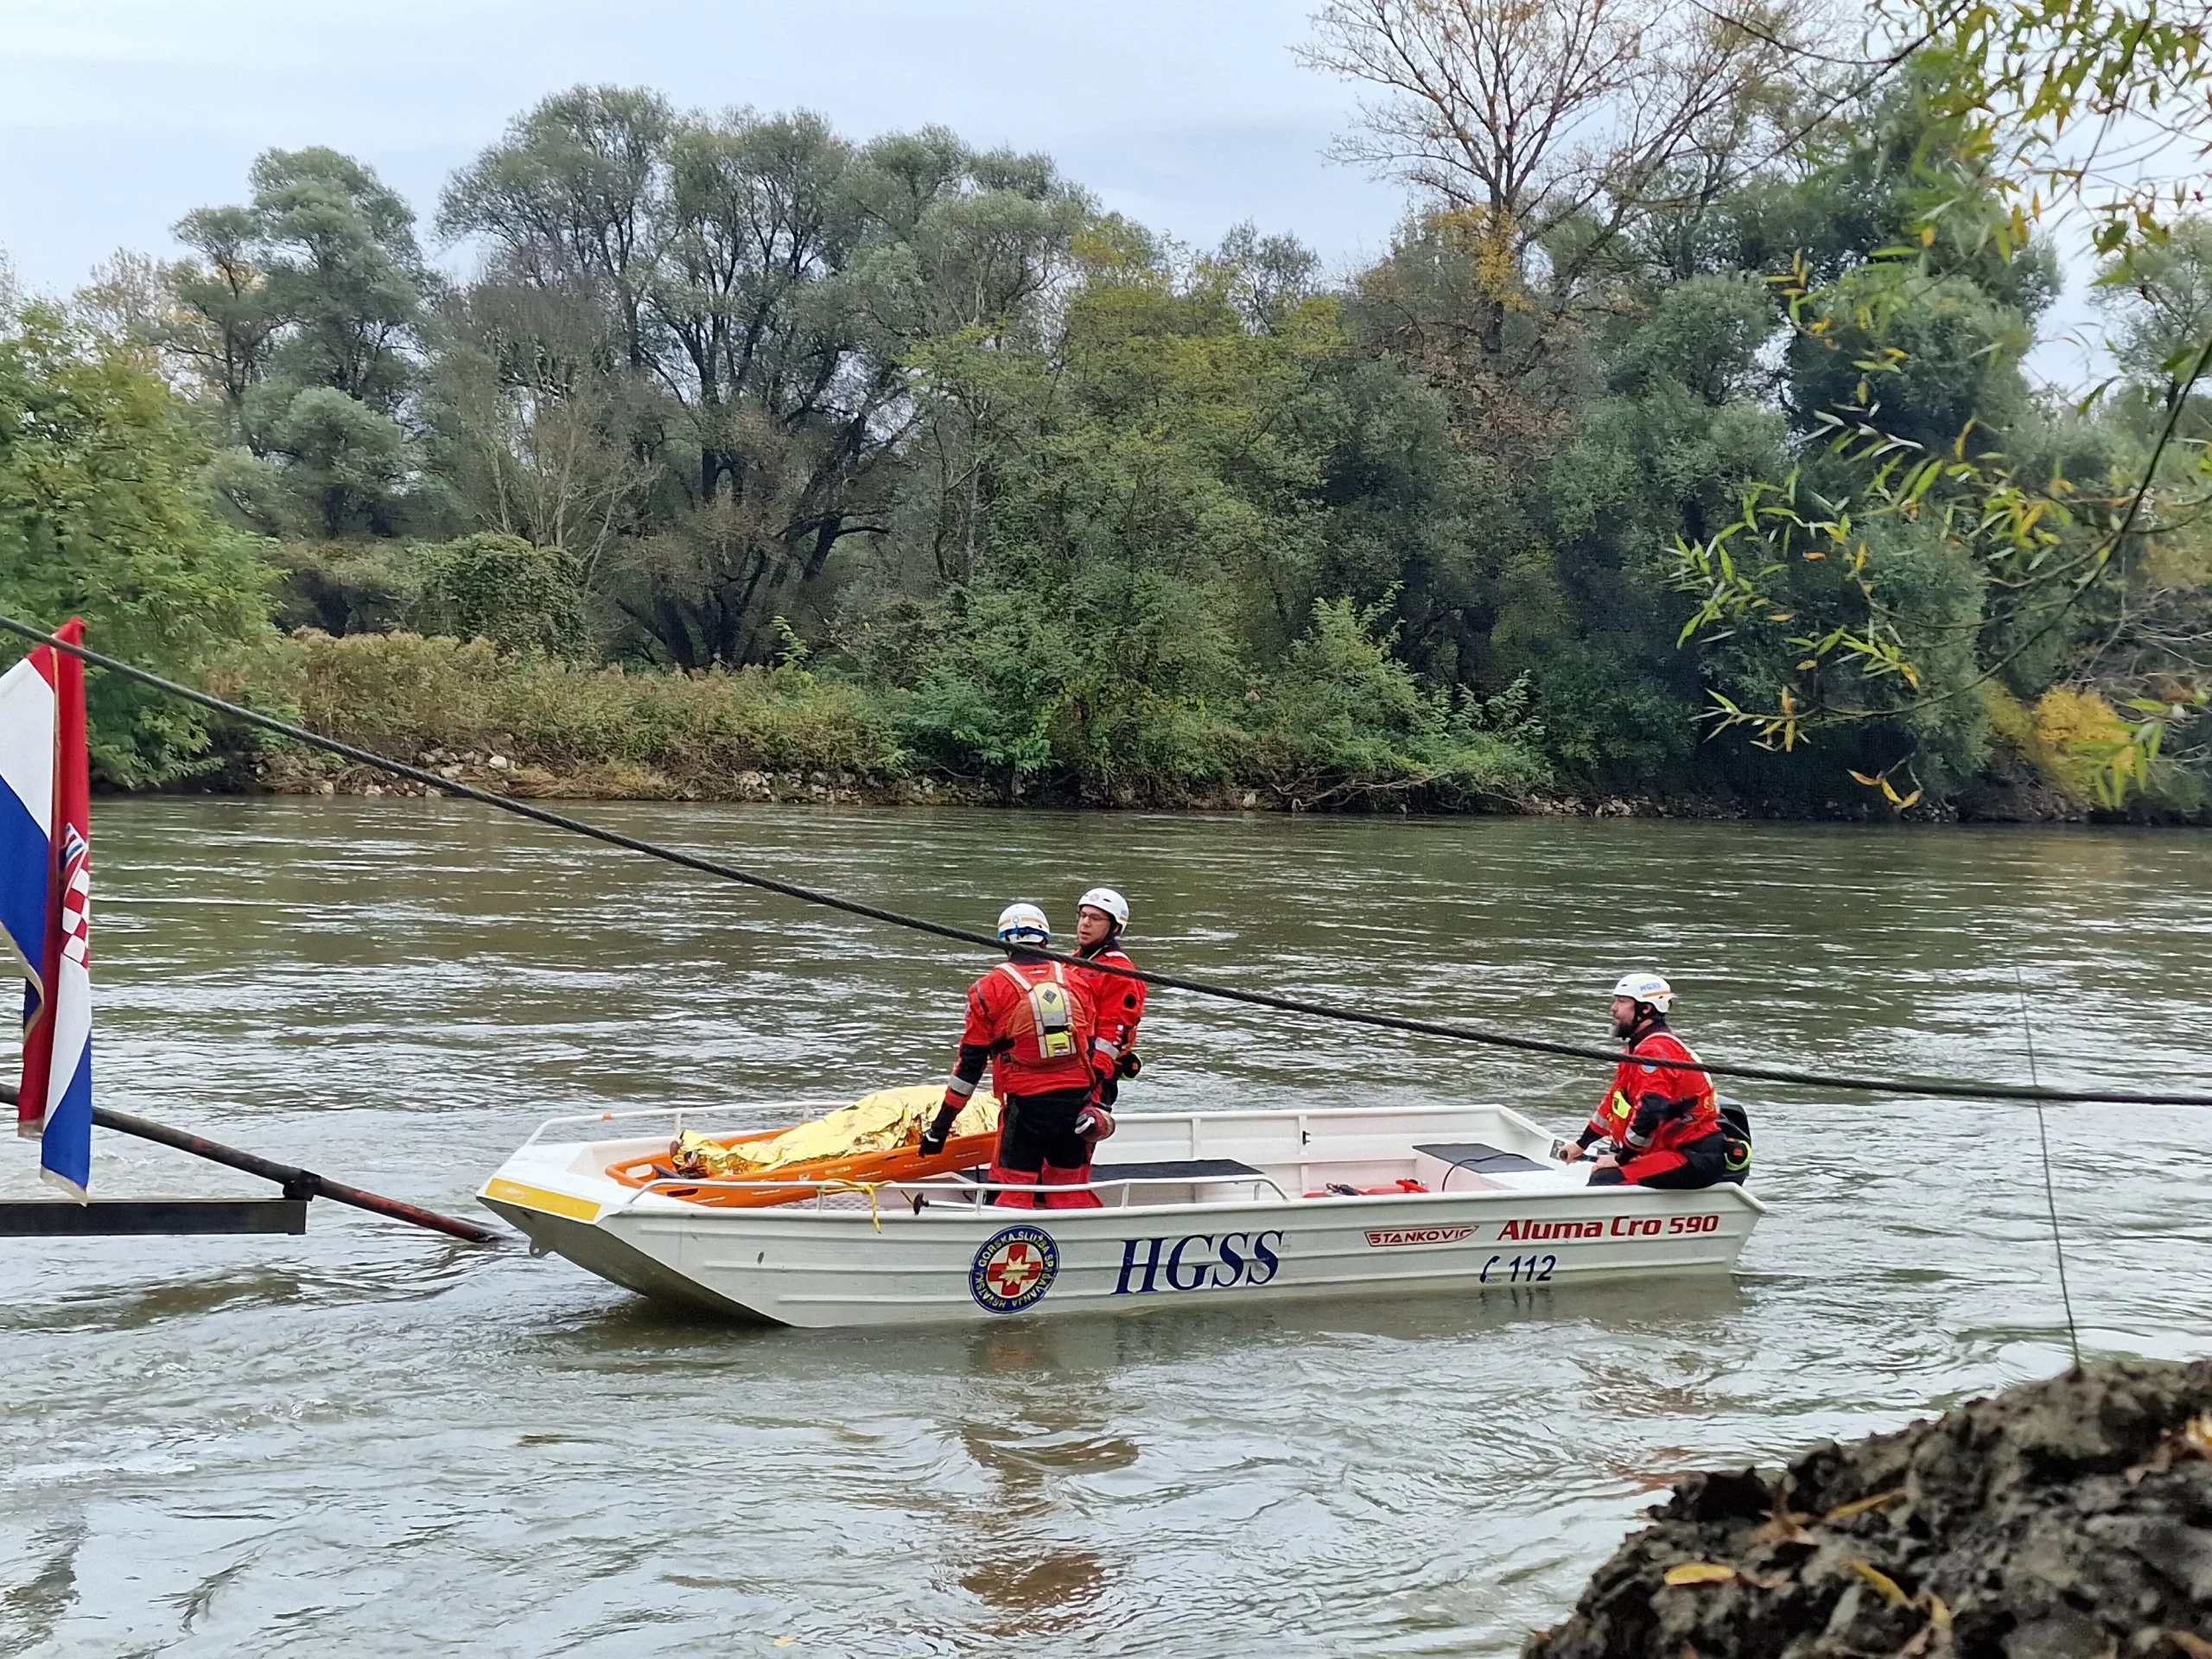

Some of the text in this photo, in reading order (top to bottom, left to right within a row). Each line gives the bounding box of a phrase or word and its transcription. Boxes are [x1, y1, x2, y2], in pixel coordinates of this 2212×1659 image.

[1017, 1230, 1051, 1254] SLUŽBA
[1497, 1215, 1719, 1241] Aluma Cro 590
[978, 1232, 1016, 1268] GORSKA
[1110, 1229, 1284, 1295] HGSS
[1509, 1254, 1557, 1282] 112
[975, 1271, 1007, 1308] HRVATSKA
